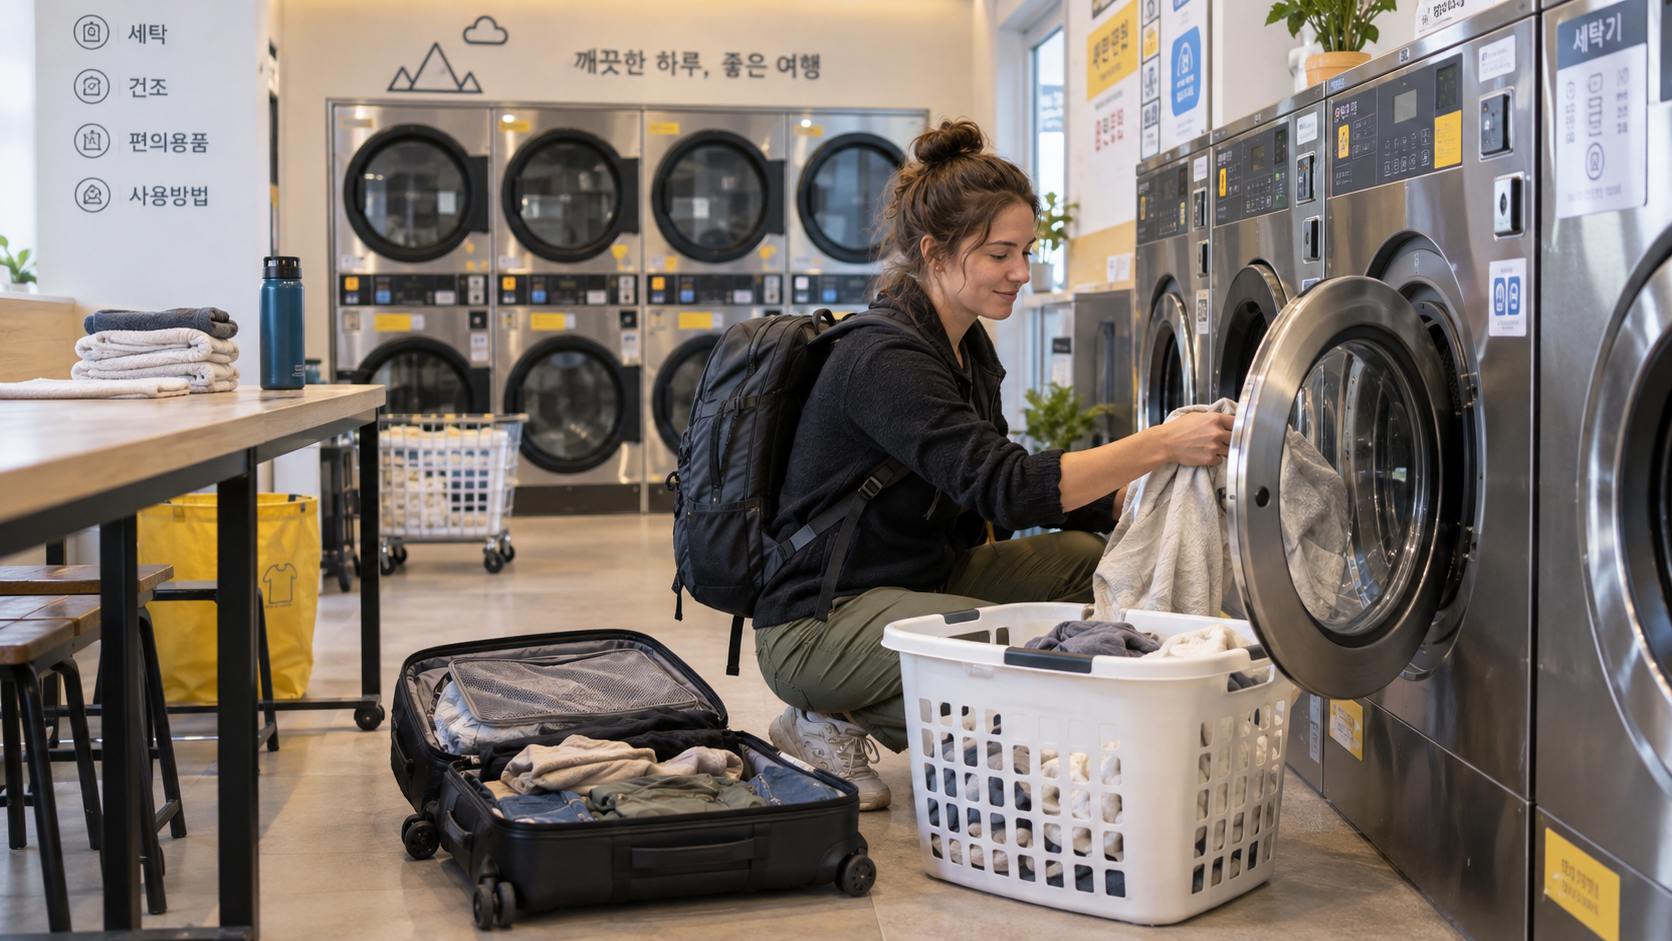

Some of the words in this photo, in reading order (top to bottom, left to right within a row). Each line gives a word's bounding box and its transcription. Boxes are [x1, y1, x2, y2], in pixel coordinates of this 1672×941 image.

[127, 23, 168, 46] 세탁
[1573, 12, 1622, 53] 세탁기
[574, 49, 646, 76] 깨끗한
[656, 51, 709, 79] 하루,
[722, 52, 768, 78] 좋은
[777, 53, 821, 80] 여행
[128, 76, 169, 98] 건조
[128, 131, 209, 154] 편의용품
[128, 185, 208, 207] 사용방법
